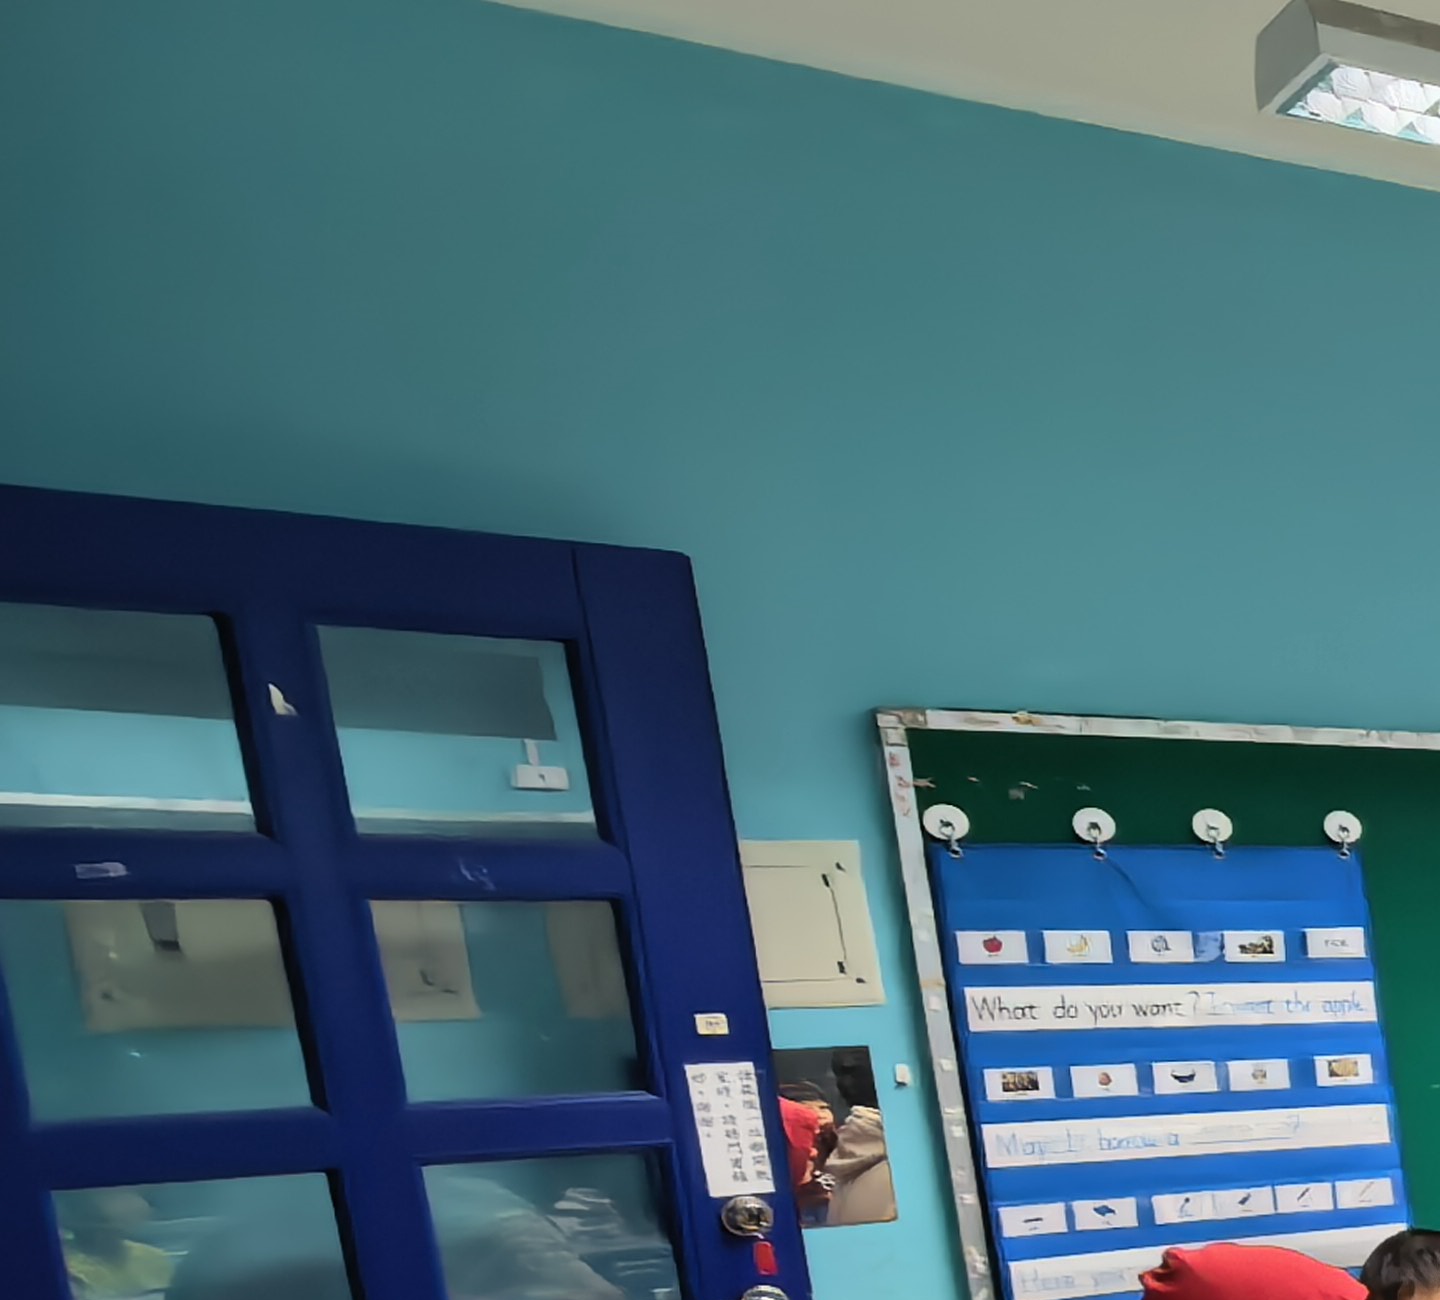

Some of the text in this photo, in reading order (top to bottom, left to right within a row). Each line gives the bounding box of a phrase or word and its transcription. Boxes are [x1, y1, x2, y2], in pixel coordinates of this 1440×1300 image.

[972, 994, 1039, 1022] What
[1053, 994, 1079, 1020] do
[1084, 1001, 1124, 1026] you
